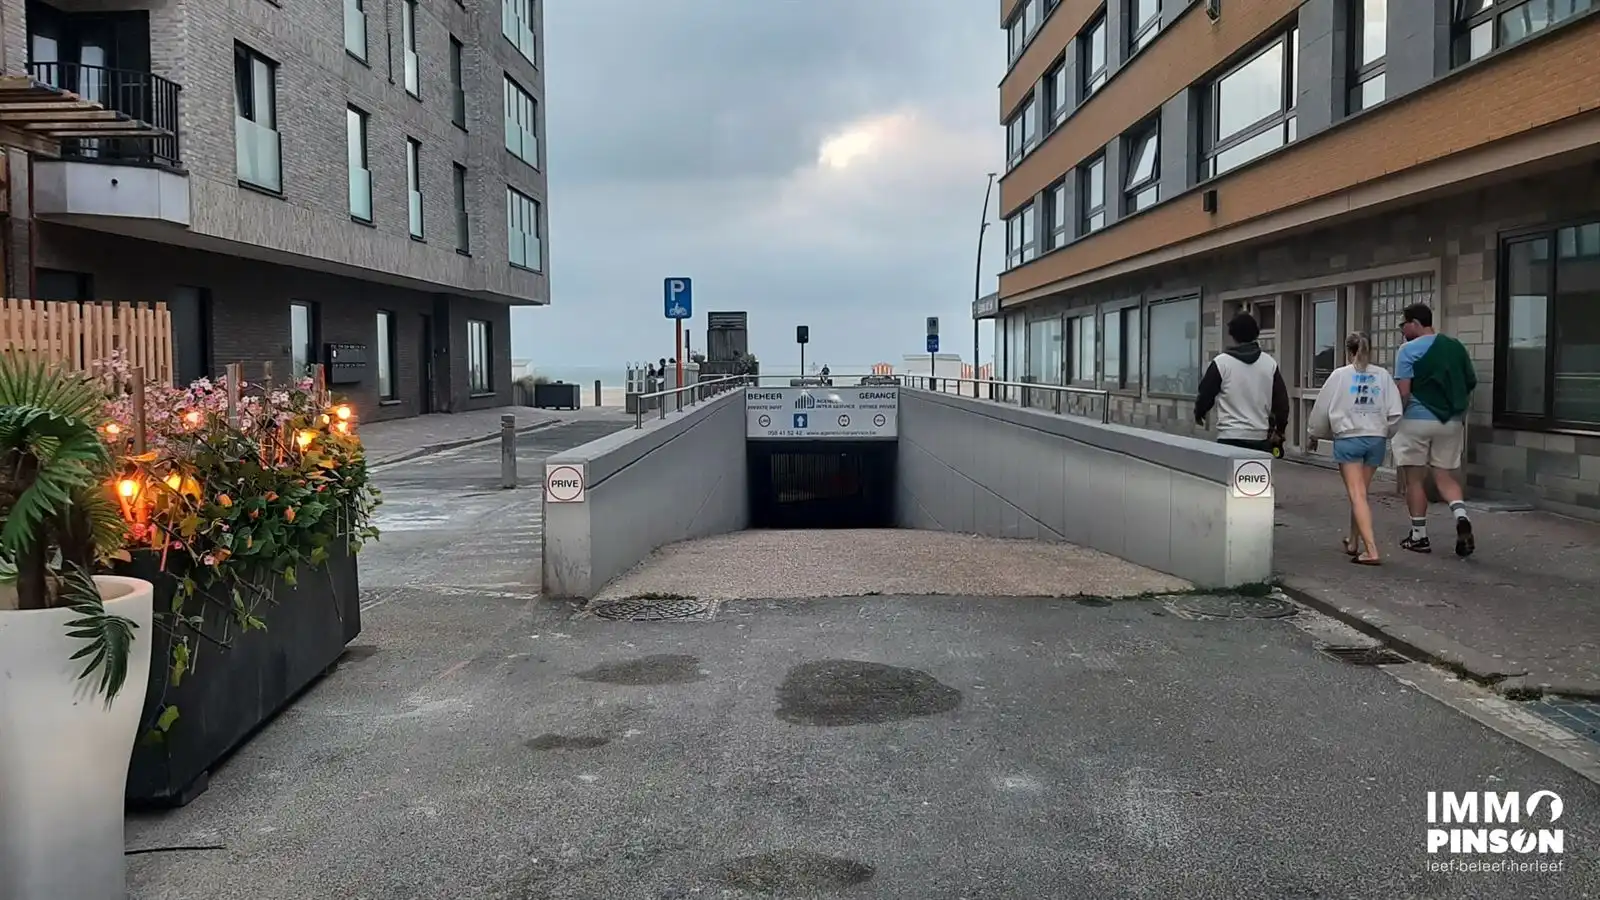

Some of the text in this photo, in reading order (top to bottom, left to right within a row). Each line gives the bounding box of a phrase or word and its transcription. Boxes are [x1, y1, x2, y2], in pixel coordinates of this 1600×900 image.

[671, 280, 685, 301] P
[747, 392, 782, 400] BEHEER
[1238, 474, 1266, 483] PRIVE
[551, 479, 579, 488] PRIVE
